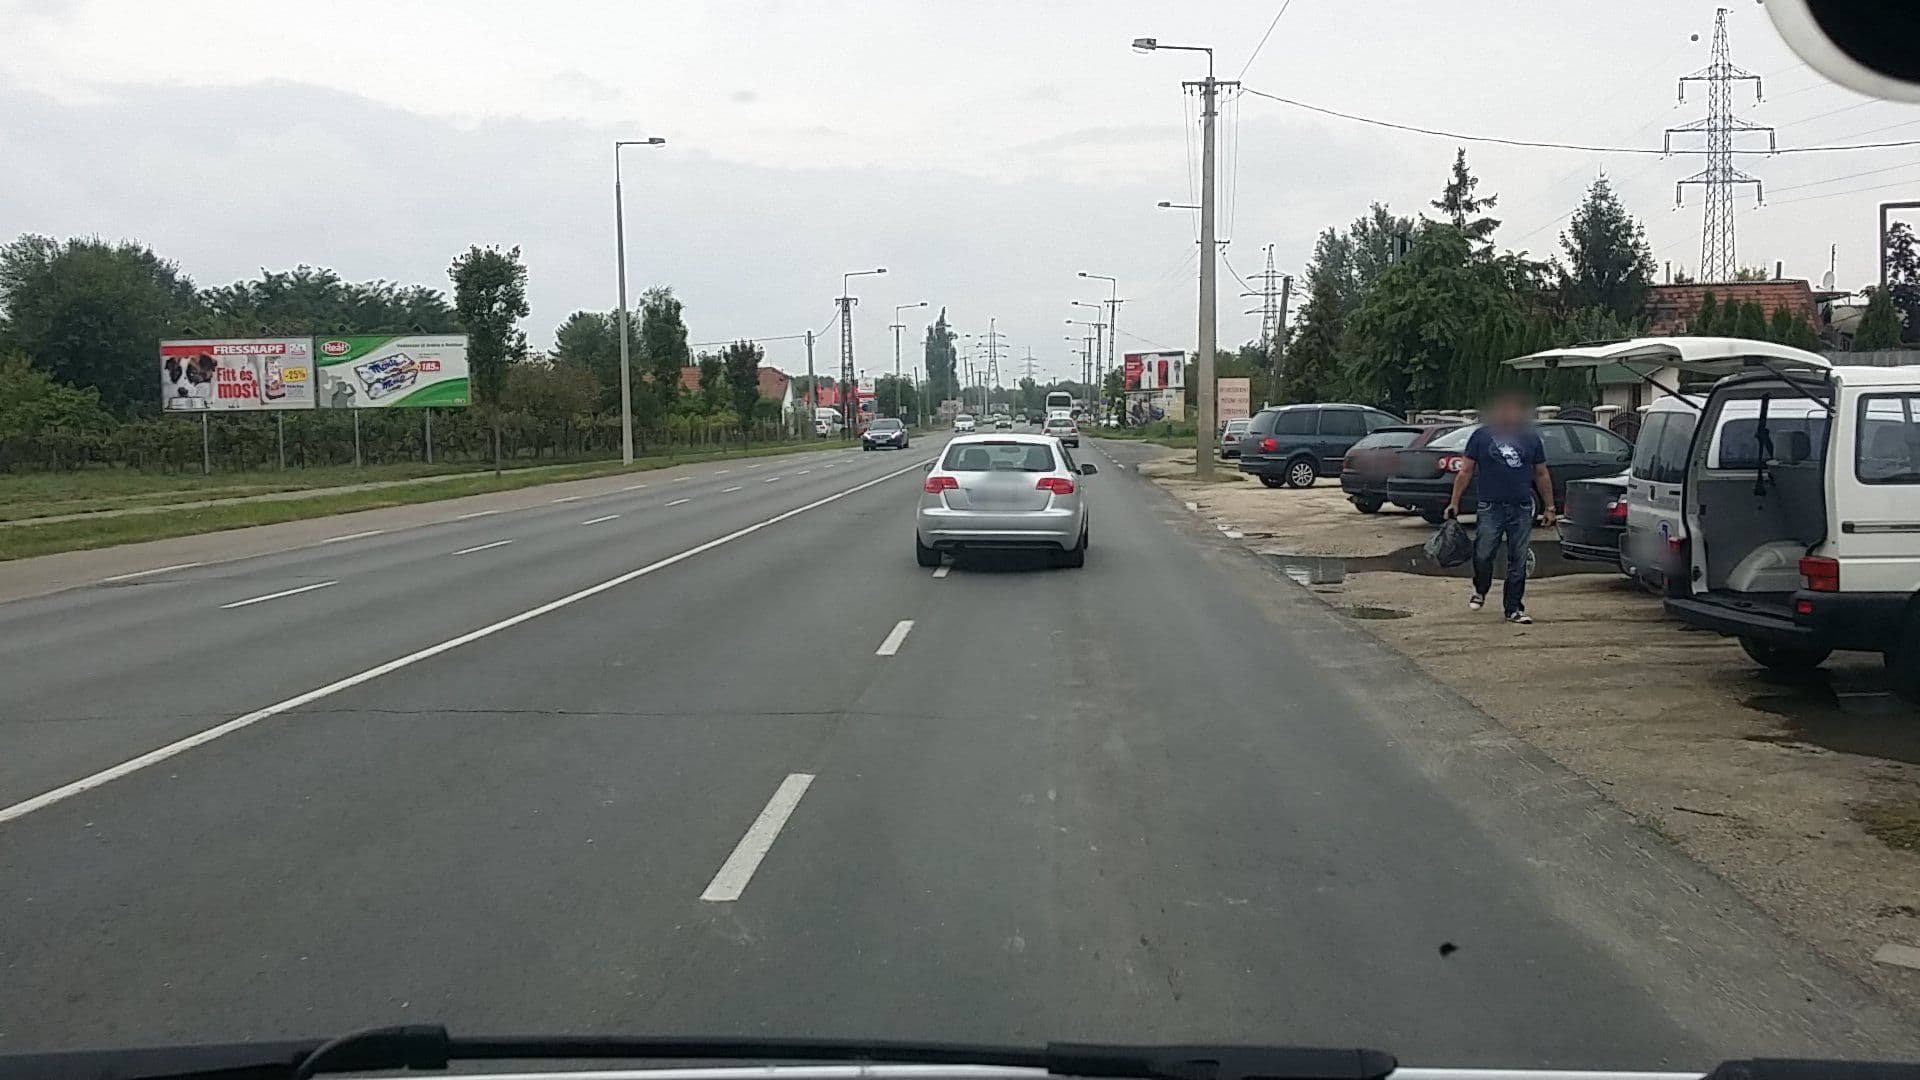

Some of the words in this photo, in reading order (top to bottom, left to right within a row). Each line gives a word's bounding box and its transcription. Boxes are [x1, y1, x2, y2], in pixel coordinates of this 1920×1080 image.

[213, 344, 284, 355] FRESSNAPF
[216, 367, 236, 382] Fitt
[239, 366, 253, 381] és
[217, 379, 259, 399] most
